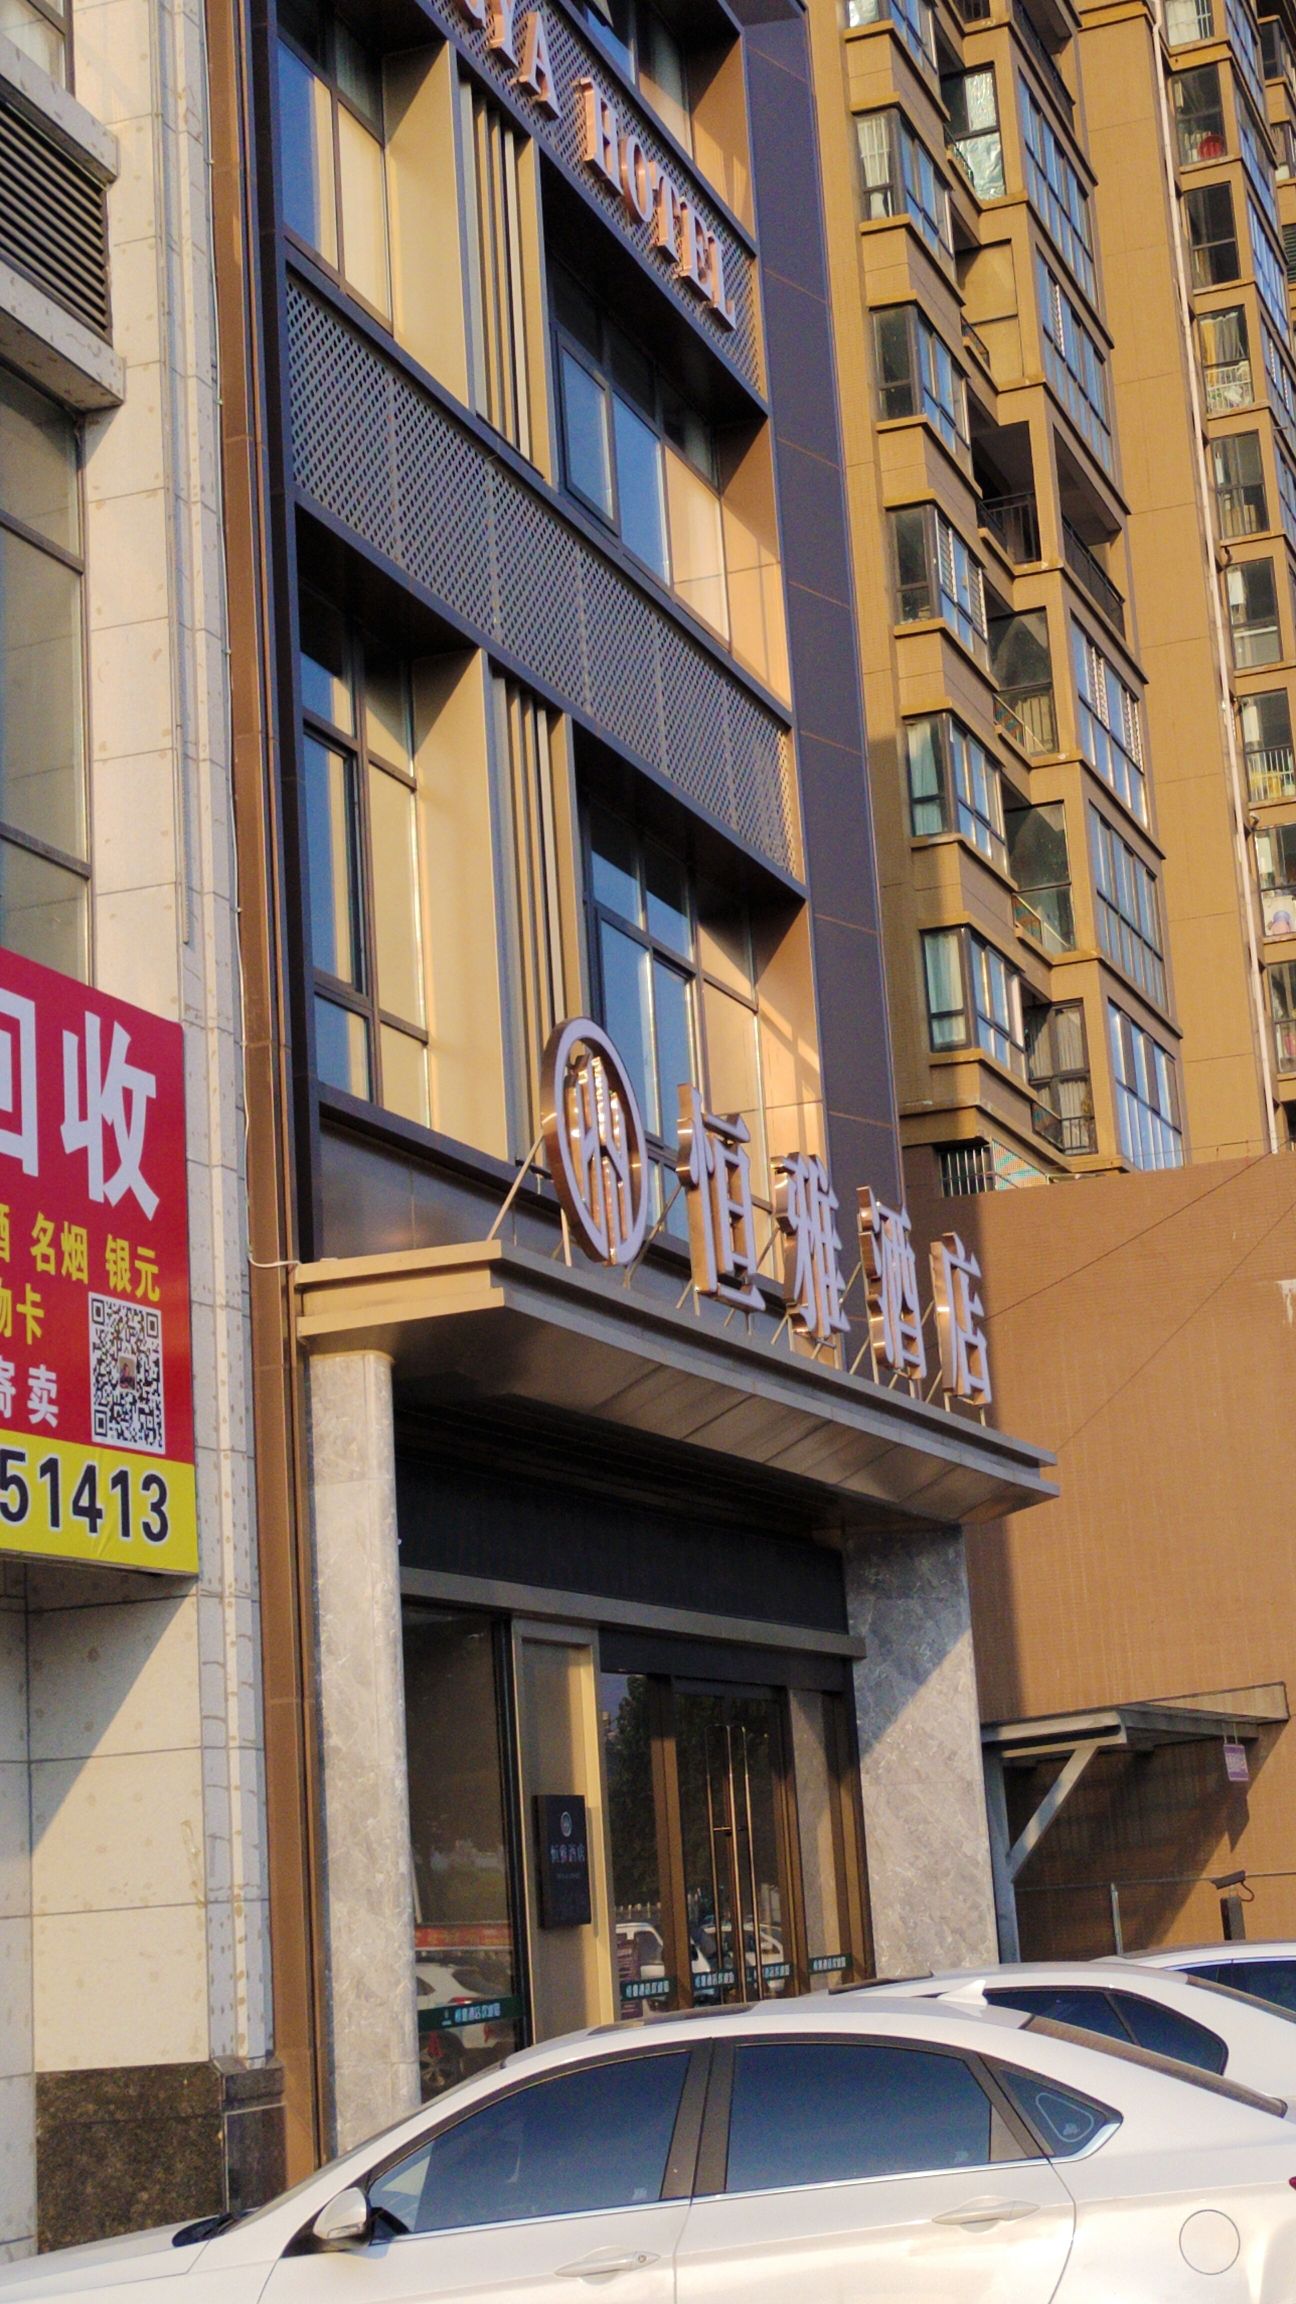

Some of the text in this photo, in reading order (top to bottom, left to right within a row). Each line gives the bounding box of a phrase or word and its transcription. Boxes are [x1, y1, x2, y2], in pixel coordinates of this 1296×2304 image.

[455, 0, 737, 332] YA HOTEL
[30, 1211, 89, 1286] 名烟
[104, 1233, 161, 1303] 银元
[677, 1082, 993, 1405] 恒雅酒店
[0, 1447, 170, 1543] 51413
